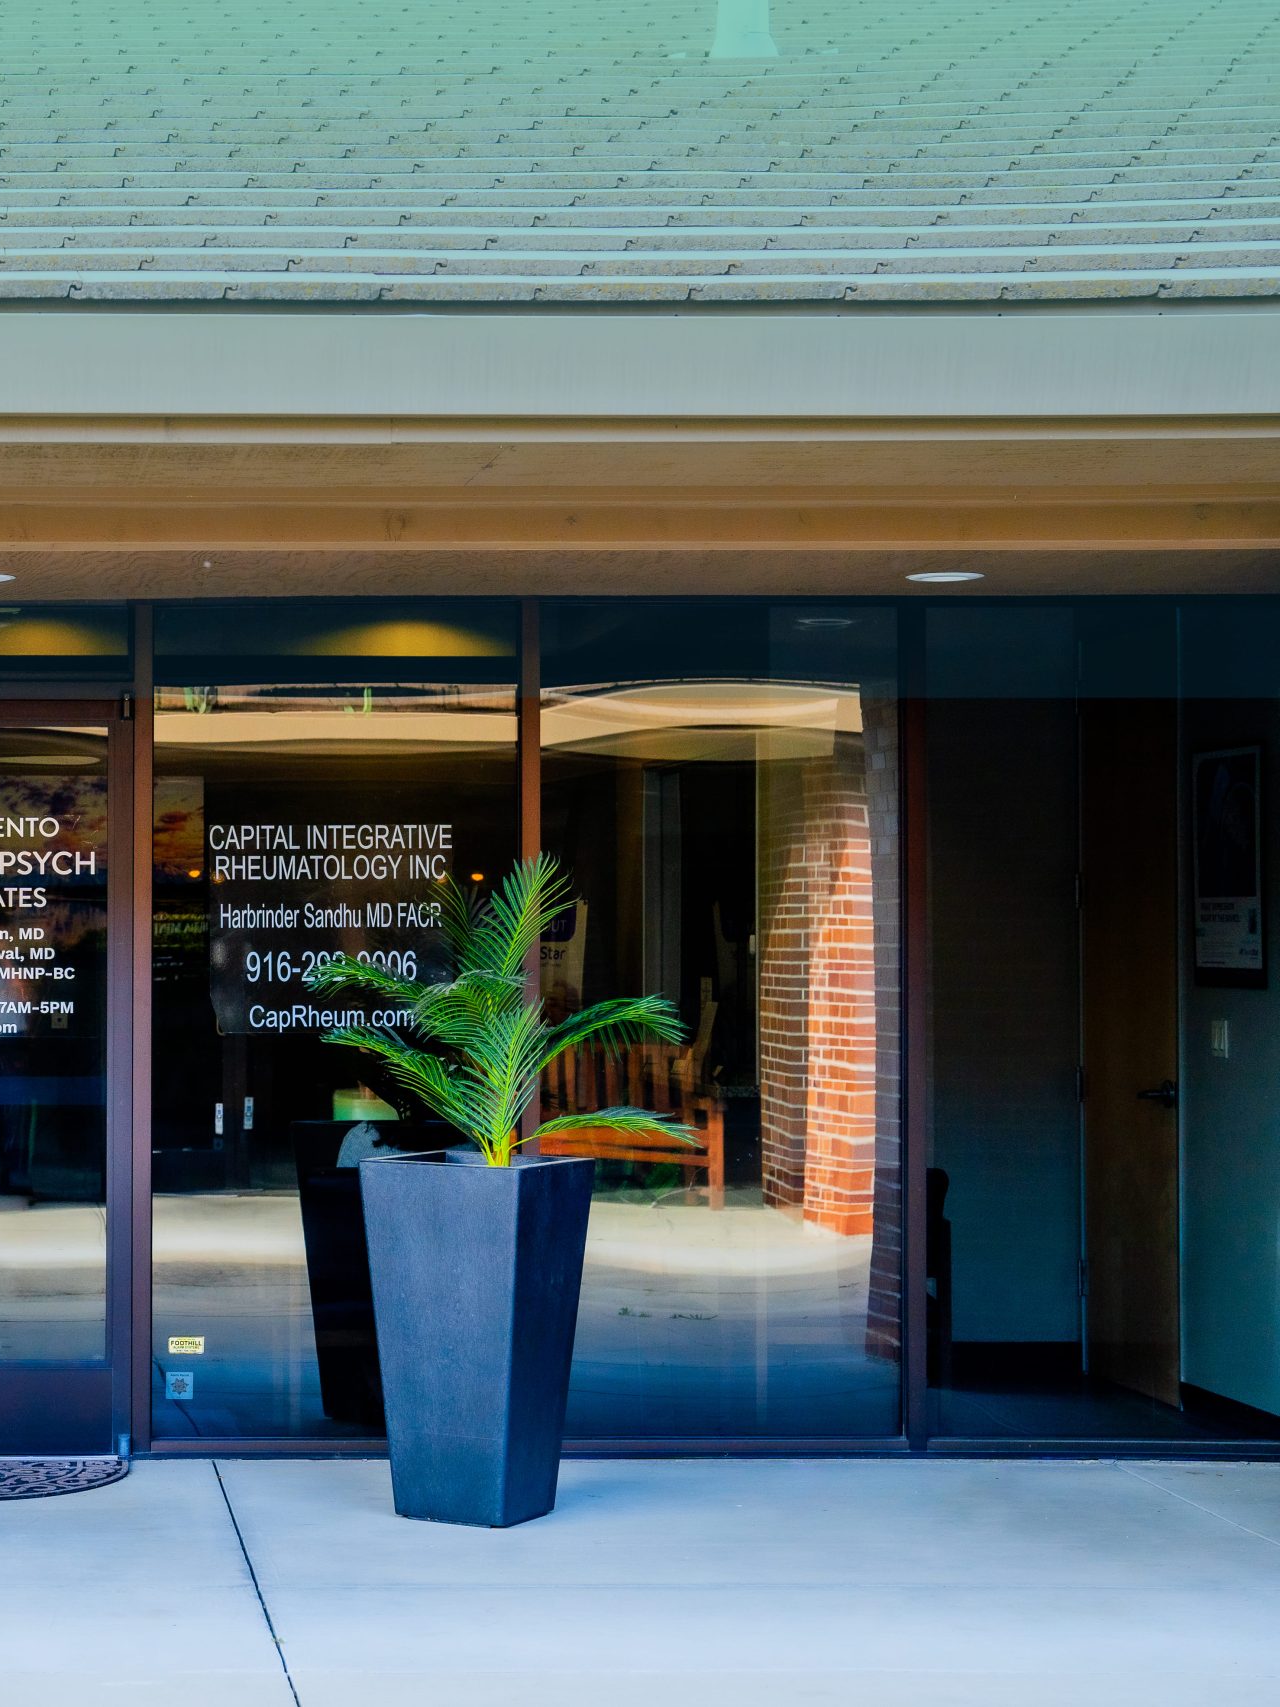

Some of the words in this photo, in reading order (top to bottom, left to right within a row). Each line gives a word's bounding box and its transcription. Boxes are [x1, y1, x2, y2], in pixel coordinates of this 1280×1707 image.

[209, 824, 301, 851] CAPITAL
[307, 824, 453, 850] INTEGRATIVE
[0, 850, 96, 875] PSYCH
[215, 854, 403, 880] RHEUMATOLOGY
[409, 854, 447, 880] INC
[220, 902, 299, 928] Harbrinder
[304, 902, 361, 928] Sandhu
[366, 903, 393, 928] MD
[397, 902, 443, 928] FACR
[19, 927, 45, 940] MD
[29, 947, 55, 960] MD
[249, 1005, 415, 1033] CapRheum.com
